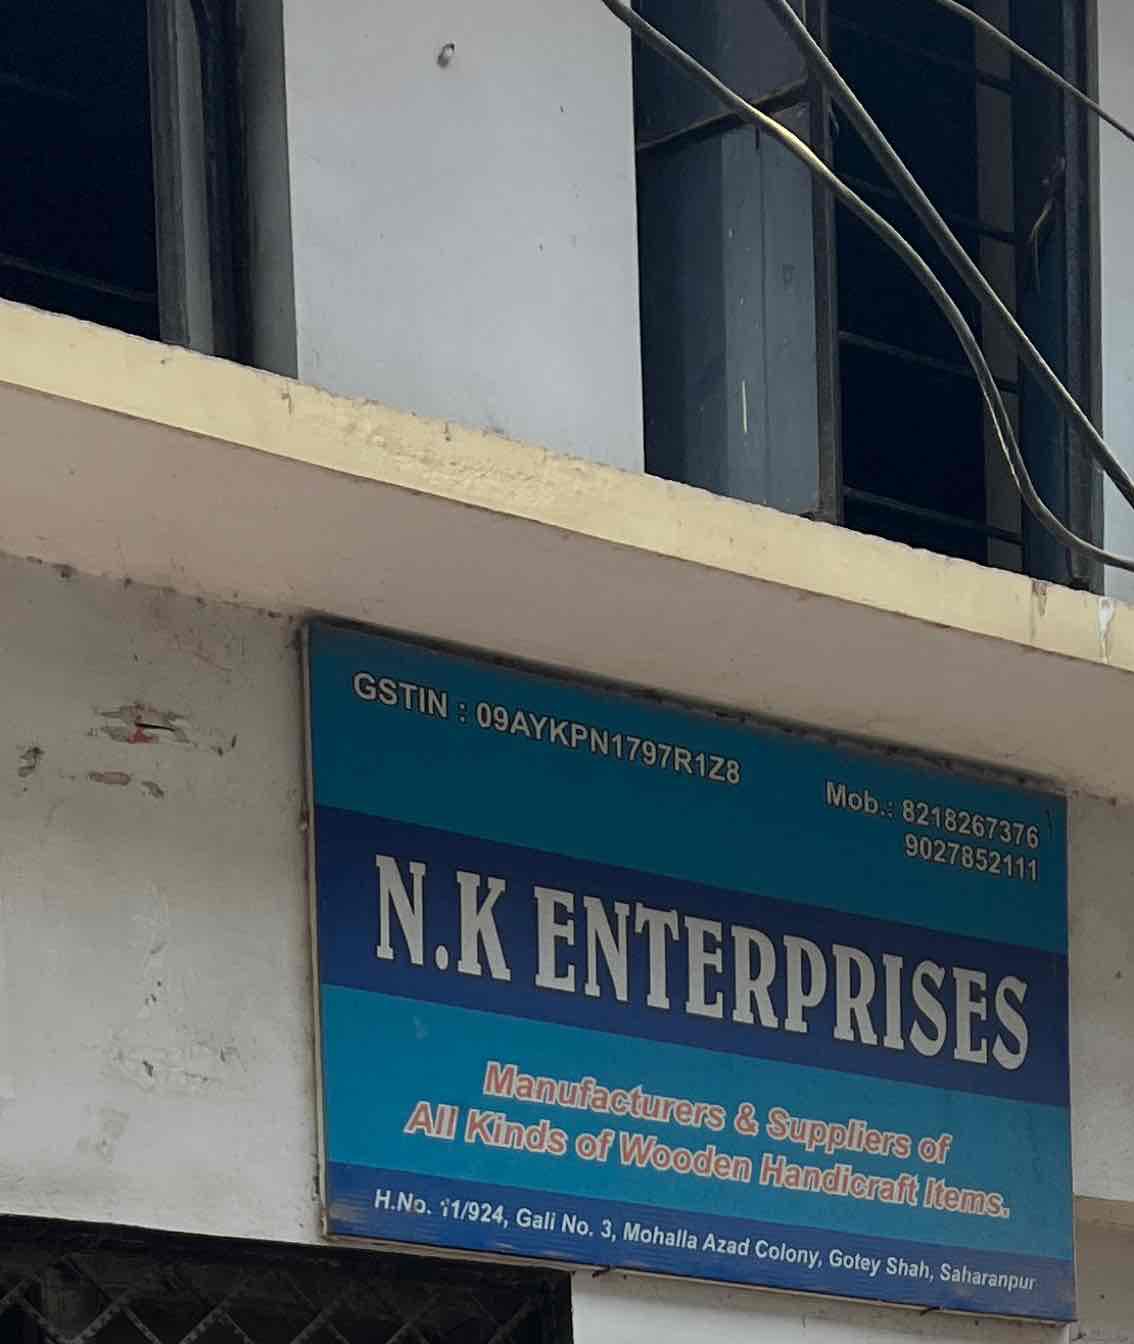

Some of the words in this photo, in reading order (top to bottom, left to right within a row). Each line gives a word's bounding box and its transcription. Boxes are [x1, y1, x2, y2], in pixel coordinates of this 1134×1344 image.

[352, 672, 448, 718] GSTIN
[476, 702, 741, 785] 09AYKPN1797R1Z8
[902, 800, 1039, 848] 8218267376
[905, 834, 1038, 880] 9027852111
[376, 854, 512, 981] N.K
[534, 885, 1029, 1070] ENTERPRISES
[404, 1101, 459, 1140] All
[465, 1108, 569, 1155] Kinds
[576, 1129, 615, 1161] of
[619, 1131, 752, 1183] Wooden
[760, 1152, 920, 1206] Handicraft
[924, 1176, 1009, 1218] Items.
[483, 1060, 726, 1131] Manufacturers
[734, 1102, 759, 1136] &
[767, 1106, 912, 1159] Suppliers
[918, 1133, 952, 1164] of
[374, 1188, 432, 1215] H.No.
[515, 1208, 556, 1231] Gali
[562, 1214, 594, 1237] No.
[600, 1219, 616, 1242] 3,
[623, 1222, 698, 1249] Mohalla
[702, 1233, 750, 1256] Azad
[755, 1240, 824, 1269] Colony,
[829, 1250, 881, 1276] Gotey
[886, 1257, 935, 1282] Shah,
[940, 1263, 1038, 1292] Saharanpur
